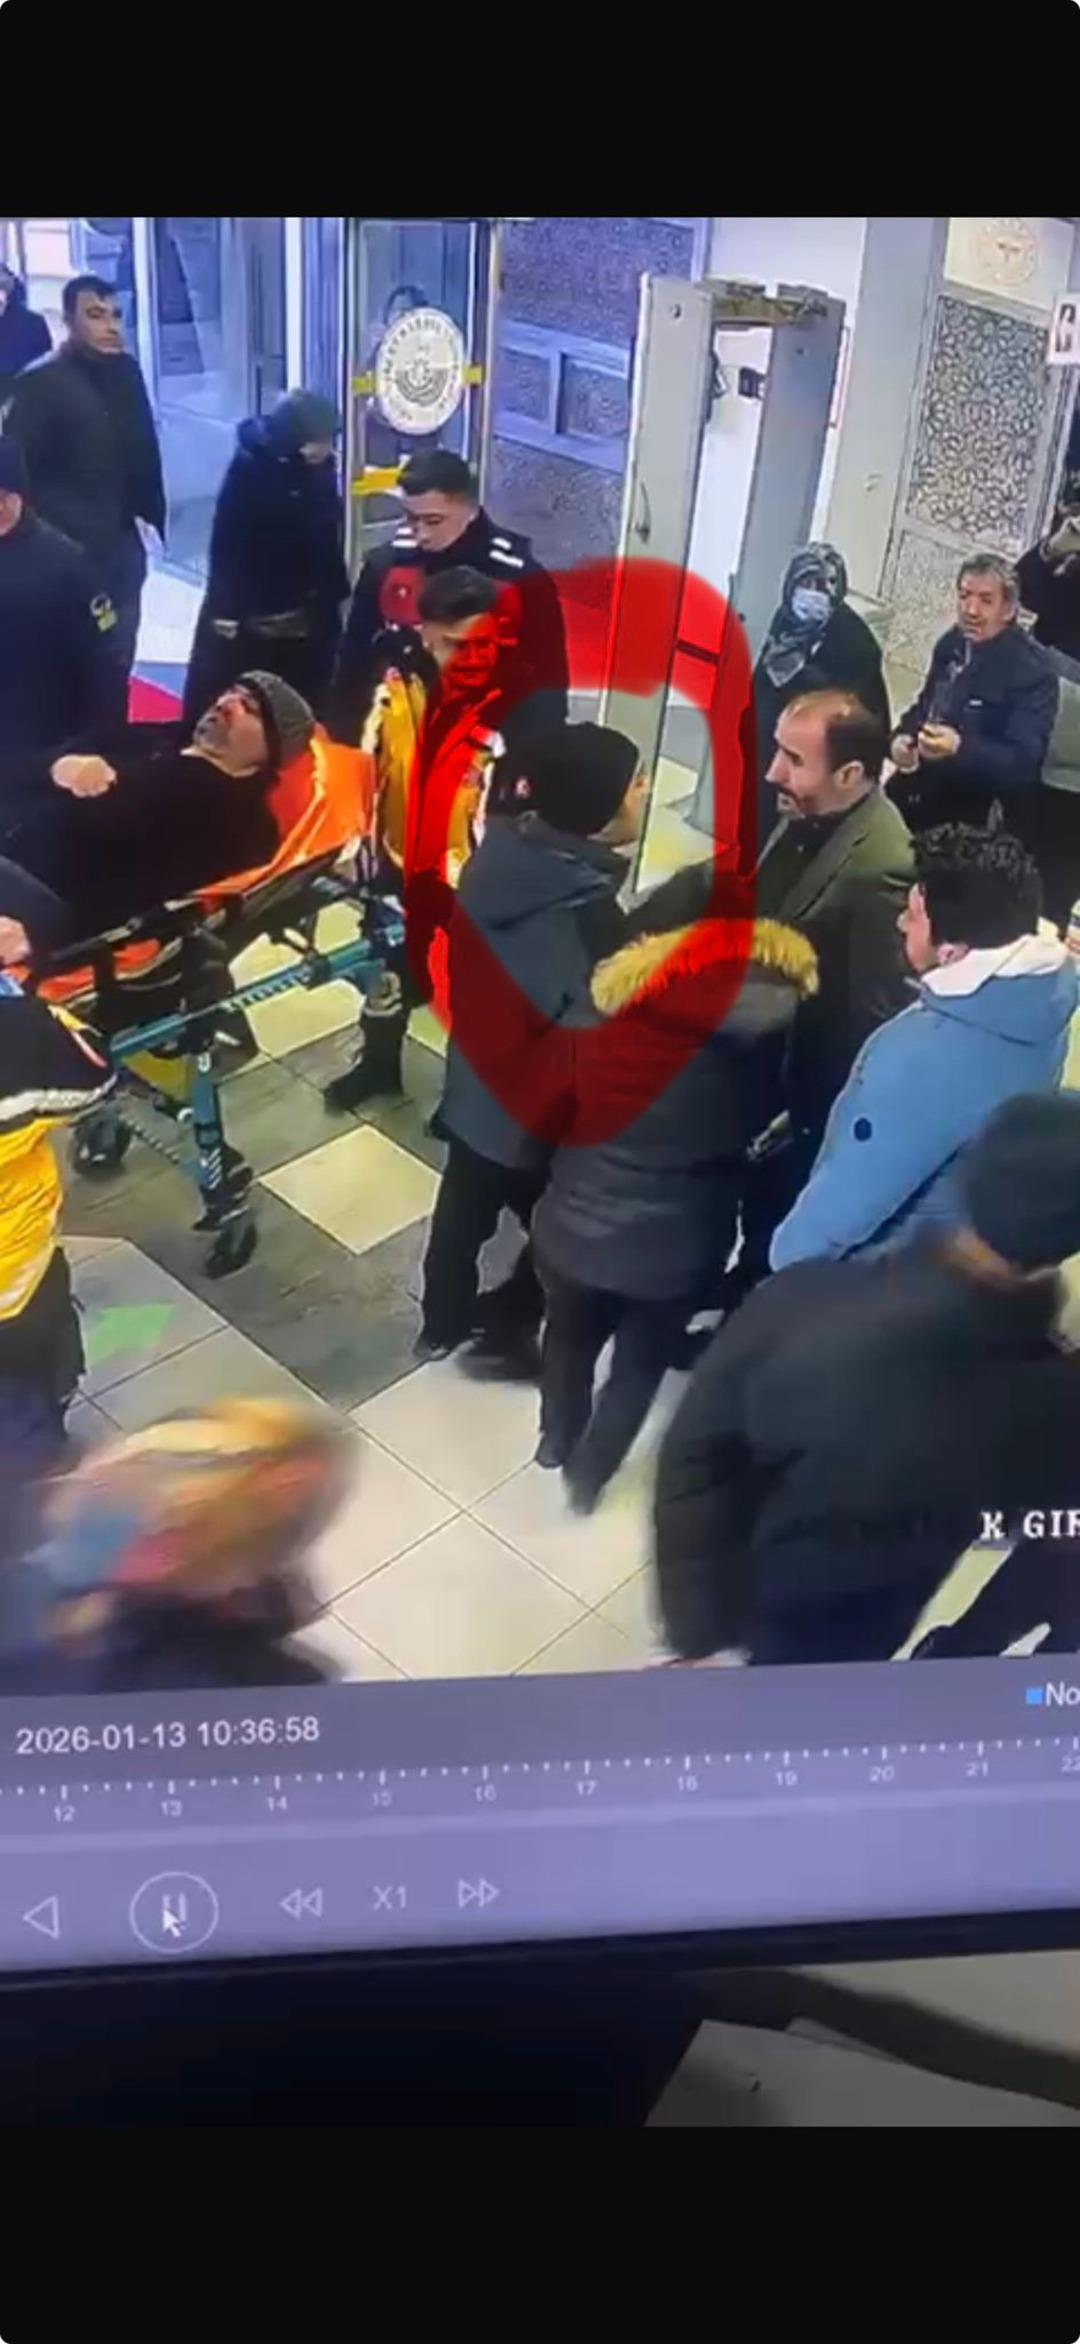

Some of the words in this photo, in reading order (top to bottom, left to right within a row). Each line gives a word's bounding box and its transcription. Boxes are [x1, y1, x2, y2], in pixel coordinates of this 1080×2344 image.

[1045, 1681, 1080, 1706] No
[16, 1722, 187, 1754] 2026-01-13
[197, 1716, 320, 1746] 10:36:58
[54, 1805, 75, 1822] 12
[161, 1800, 183, 1817] 13
[266, 1796, 288, 1812] 14
[474, 1784, 497, 1802] 16
[576, 1780, 598, 1797] 17
[775, 1771, 798, 1787] 19
[869, 1765, 896, 1783] 20
[966, 1761, 989, 1778] 21
[372, 1885, 407, 1911] X1
